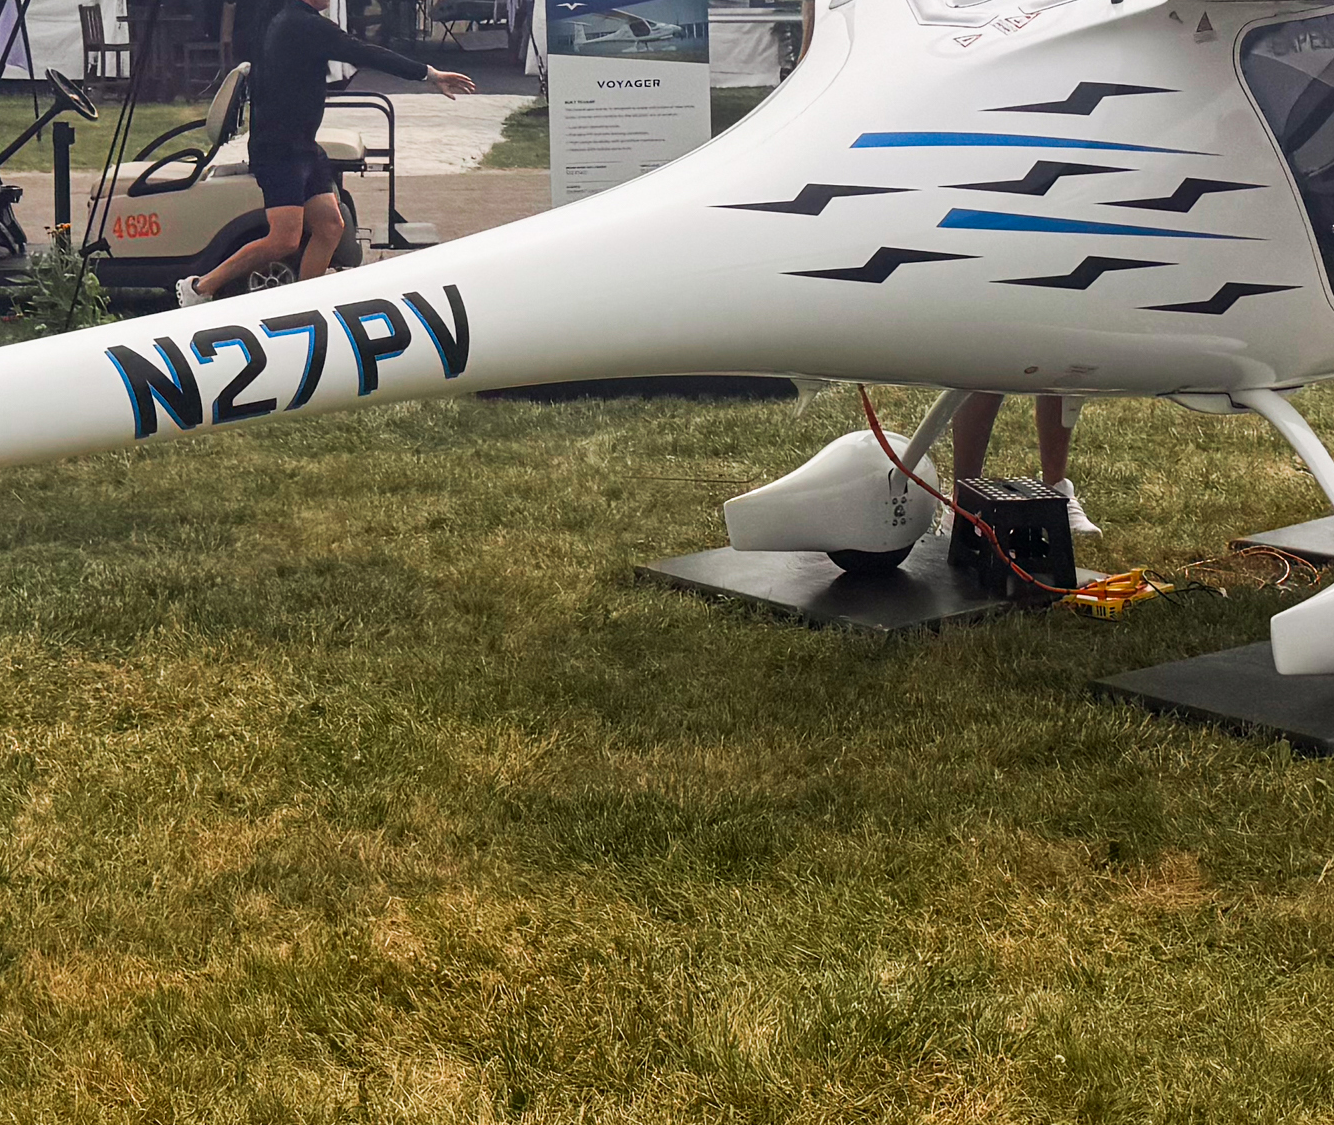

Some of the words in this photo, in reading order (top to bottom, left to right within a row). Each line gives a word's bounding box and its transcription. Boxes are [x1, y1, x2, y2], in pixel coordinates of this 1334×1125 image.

[597, 79, 661, 89] VOYAGER
[113, 213, 162, 239] 4626
[104, 284, 470, 439] N27PV
